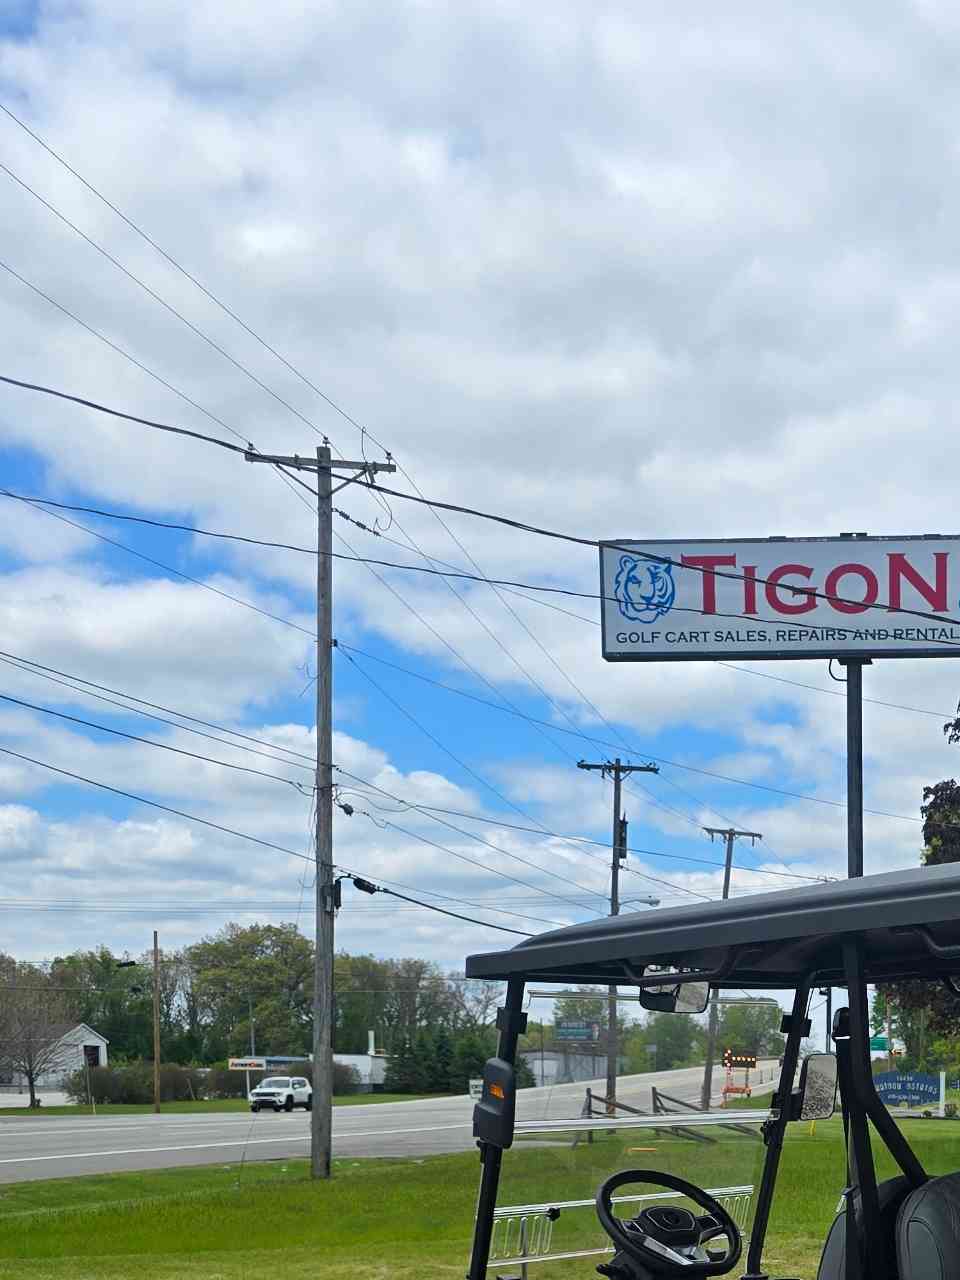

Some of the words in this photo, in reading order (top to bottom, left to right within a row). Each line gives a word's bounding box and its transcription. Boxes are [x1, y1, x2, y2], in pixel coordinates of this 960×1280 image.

[680, 552, 949, 615] TIGON
[616, 631, 661, 643] GOLF
[665, 631, 710, 643] CART
[714, 630, 771, 643] SALES,
[776, 629, 847, 641] REPAIRS
[853, 628, 890, 640] AND
